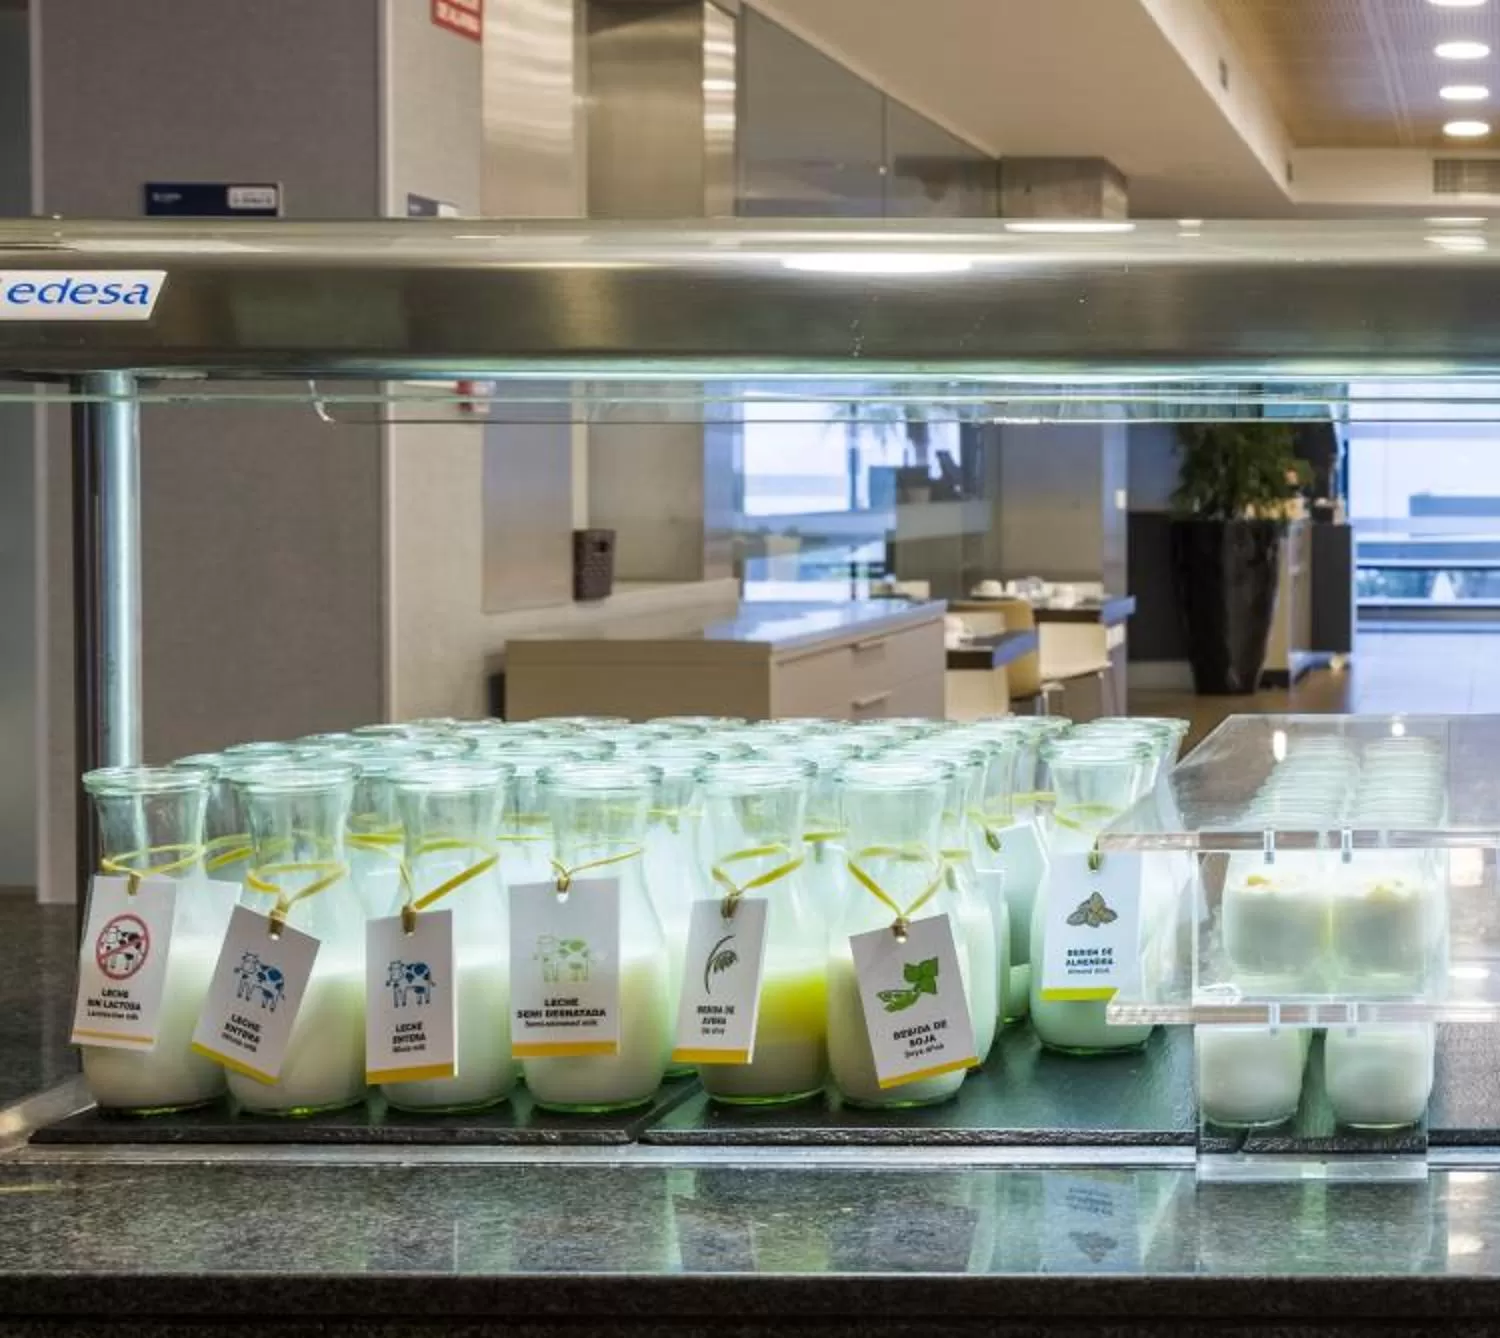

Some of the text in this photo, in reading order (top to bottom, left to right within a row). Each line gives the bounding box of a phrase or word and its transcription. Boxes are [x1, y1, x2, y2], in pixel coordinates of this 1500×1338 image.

[7, 278, 149, 305] edesa
[1102, 947, 1113, 956] DE
[102, 988, 129, 999] LECHE
[103, 1000, 141, 1011] LACTOSA
[544, 997, 579, 1007] LECHE
[545, 1008, 606, 1018] DESNATADA
[231, 1013, 262, 1033] LECHE
[395, 1022, 424, 1034] LECHE
[224, 1023, 261, 1045] ENTERA
[893, 1019, 948, 1041] BEBIDA DE
[909, 1035, 937, 1048] SOJA
